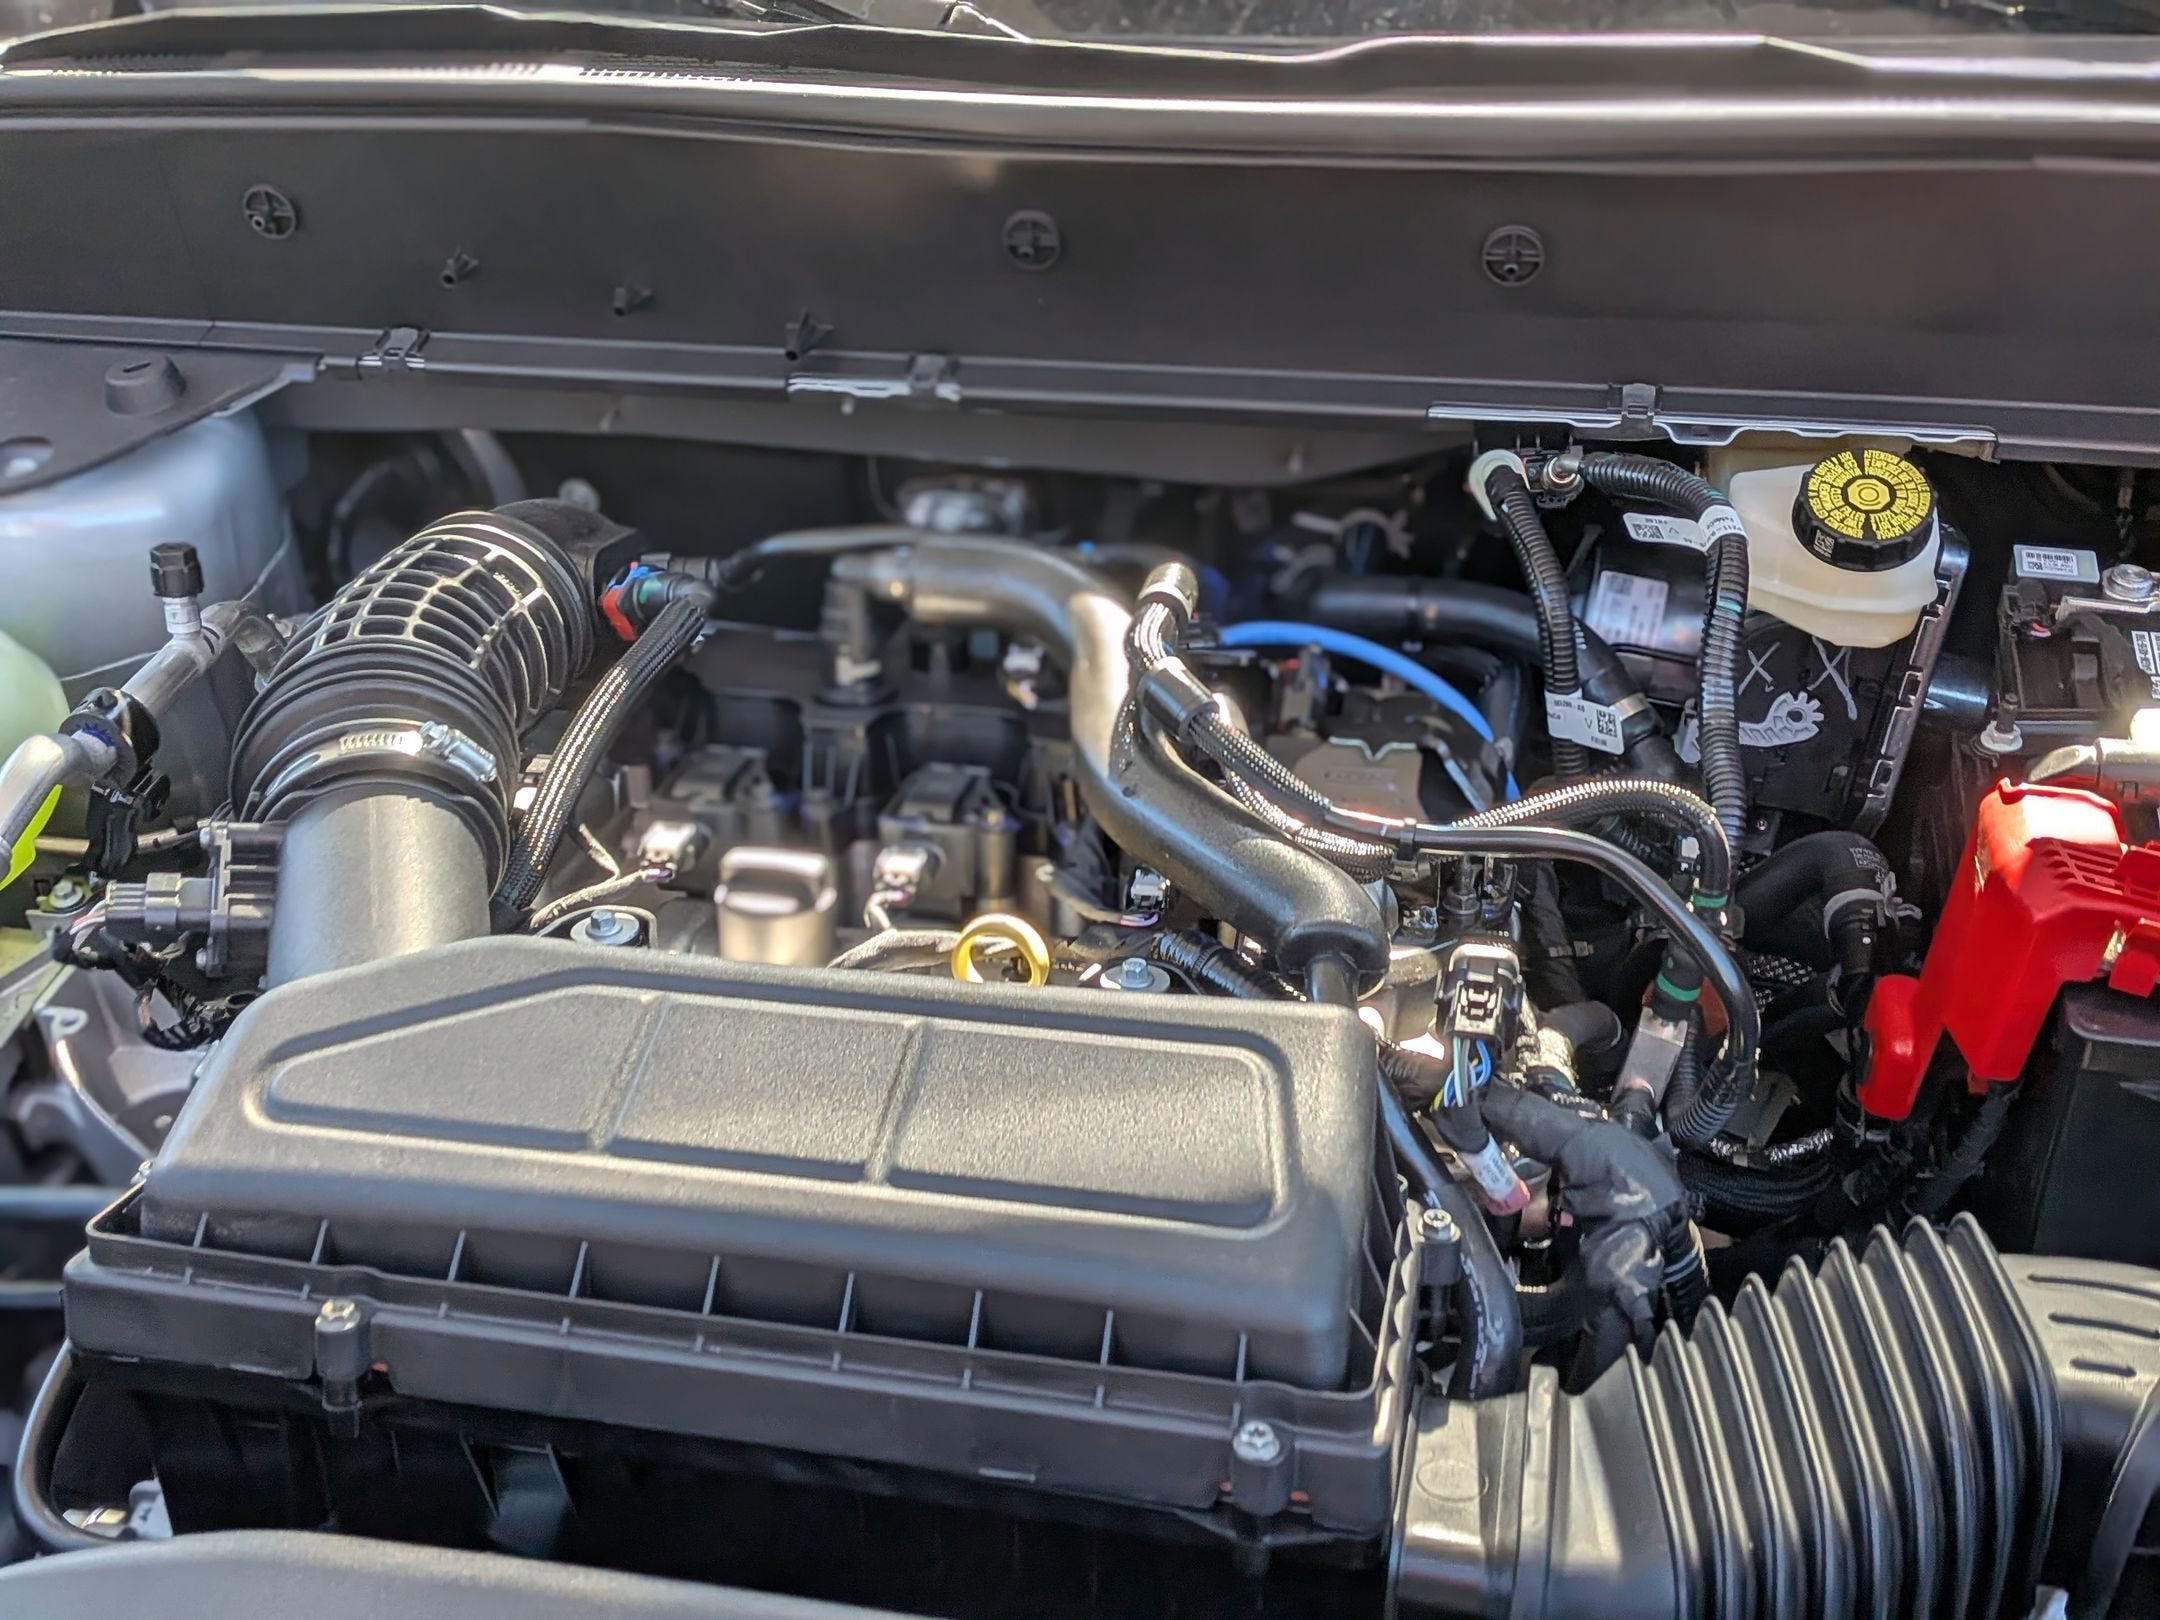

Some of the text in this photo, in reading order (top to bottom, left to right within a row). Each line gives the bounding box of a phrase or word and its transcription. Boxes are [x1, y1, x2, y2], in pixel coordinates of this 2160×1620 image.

[1838, 451, 1853, 462] DOT
[1815, 459, 1834, 476] FLUID
[1824, 516, 1864, 539] CONTAINER
